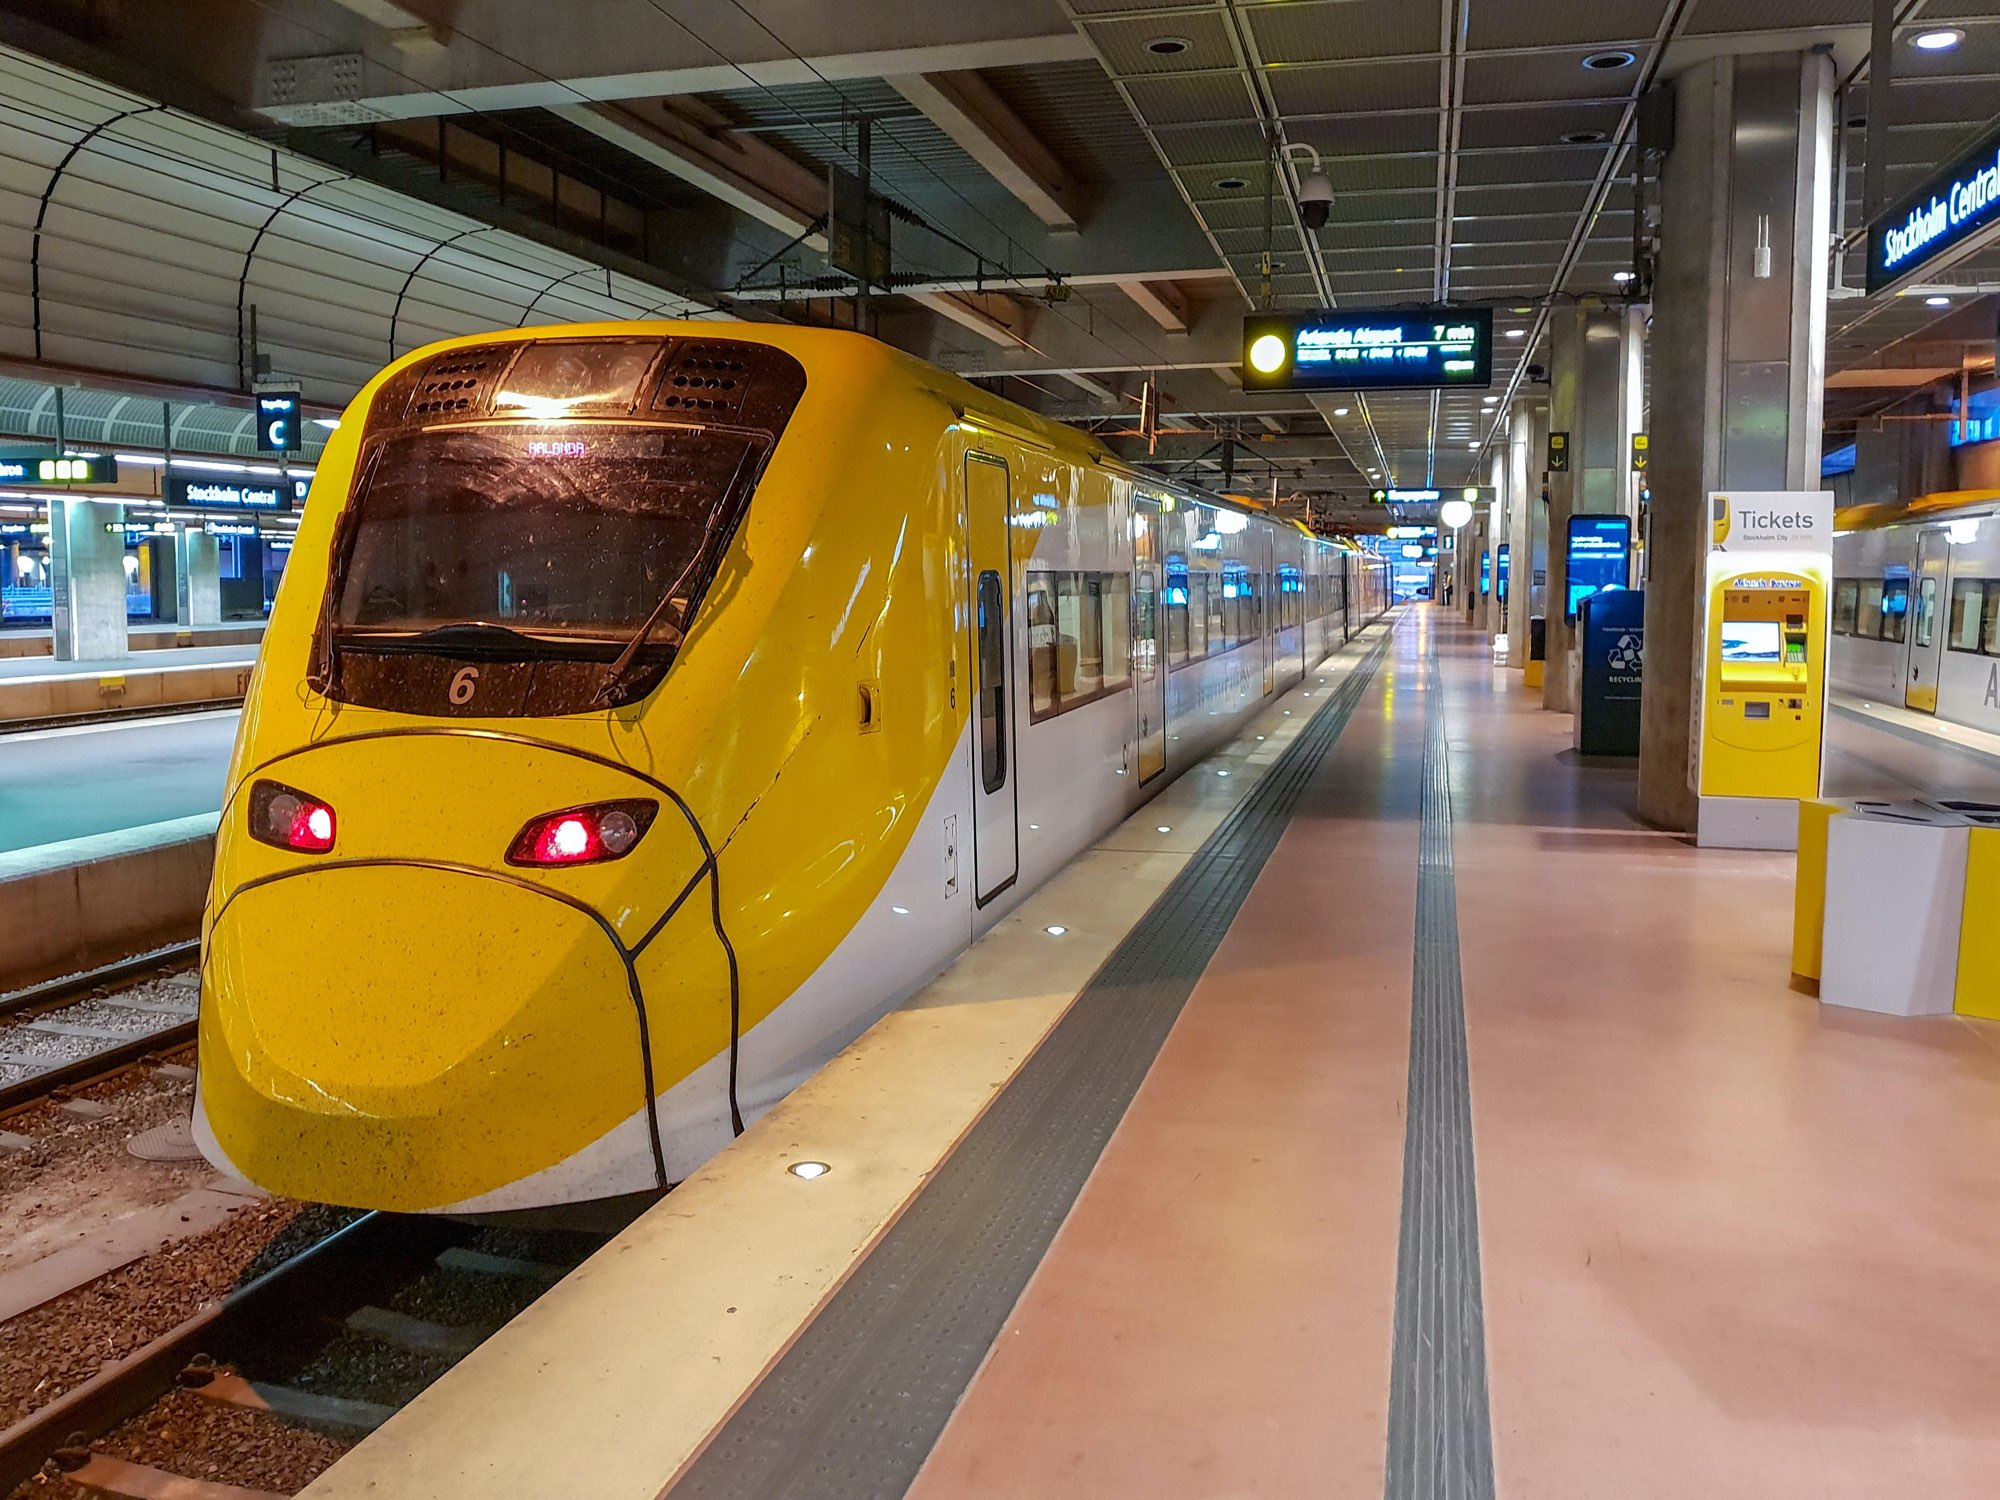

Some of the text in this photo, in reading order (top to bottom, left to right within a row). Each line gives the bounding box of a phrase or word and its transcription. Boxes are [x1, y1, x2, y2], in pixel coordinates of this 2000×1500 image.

[1884, 149, 2000, 267] Stockholm Central
[269, 420, 284, 445] C
[528, 441, 584, 455] ARLANDA
[187, 484, 276, 505] Stockholm Central
[295, 481, 306, 497] D
[1738, 510, 1814, 529] Tickets
[1776, 534, 1788, 542] City
[449, 666, 479, 705] 6
[1608, 675, 1642, 683] RECYCLIN
[1983, 662, 2000, 709] A
[950, 687, 956, 710] 6
